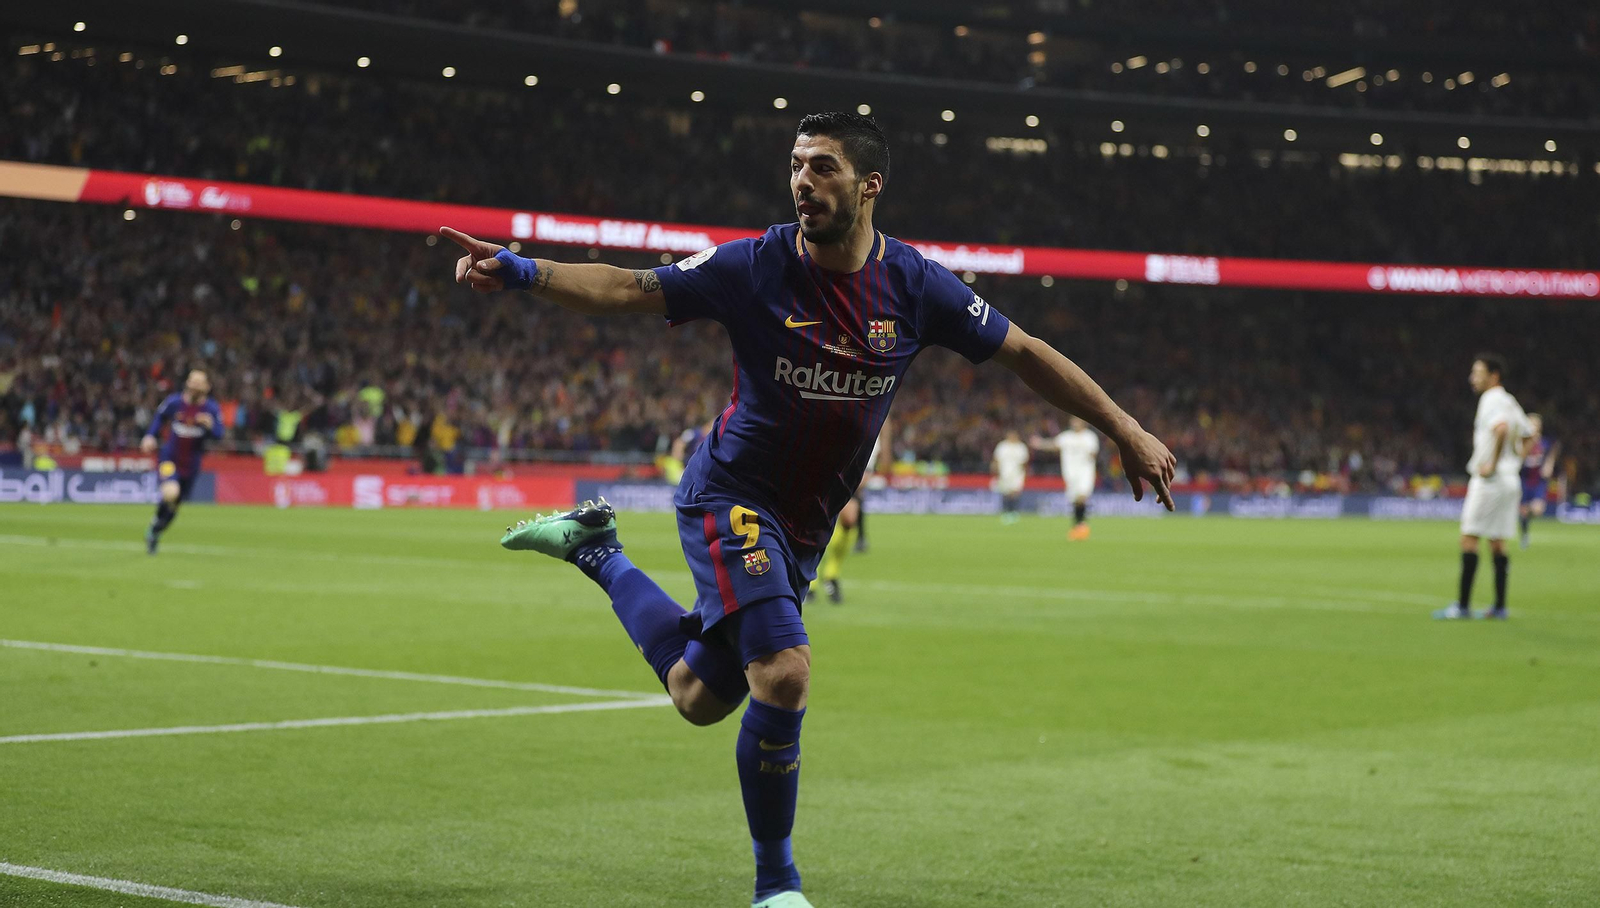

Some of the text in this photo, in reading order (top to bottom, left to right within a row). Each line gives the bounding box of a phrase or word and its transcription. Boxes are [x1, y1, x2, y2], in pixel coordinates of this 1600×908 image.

[967, 294, 984, 317] be
[774, 356, 896, 397] Rakuten
[730, 505, 760, 549] 9
